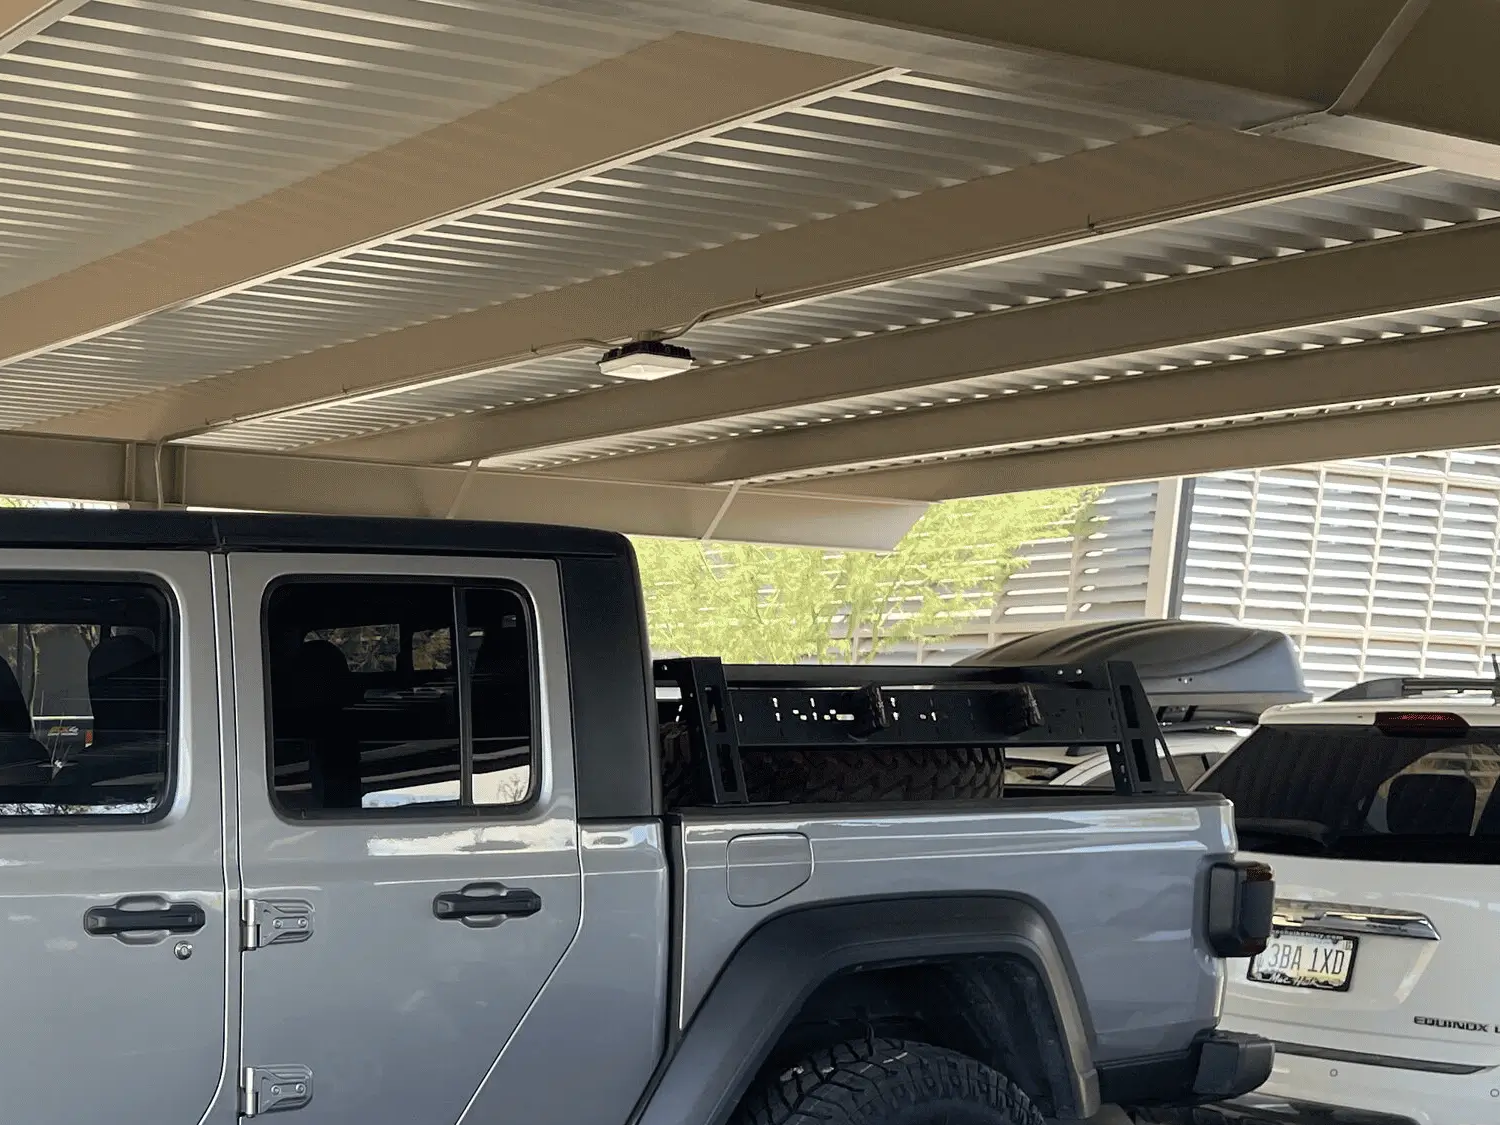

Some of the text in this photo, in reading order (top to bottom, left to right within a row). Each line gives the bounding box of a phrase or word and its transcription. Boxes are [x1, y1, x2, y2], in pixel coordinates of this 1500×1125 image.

[1269, 943, 1345, 975] 3BA 1XD
[1414, 1016, 1489, 1032] EQUINOX
